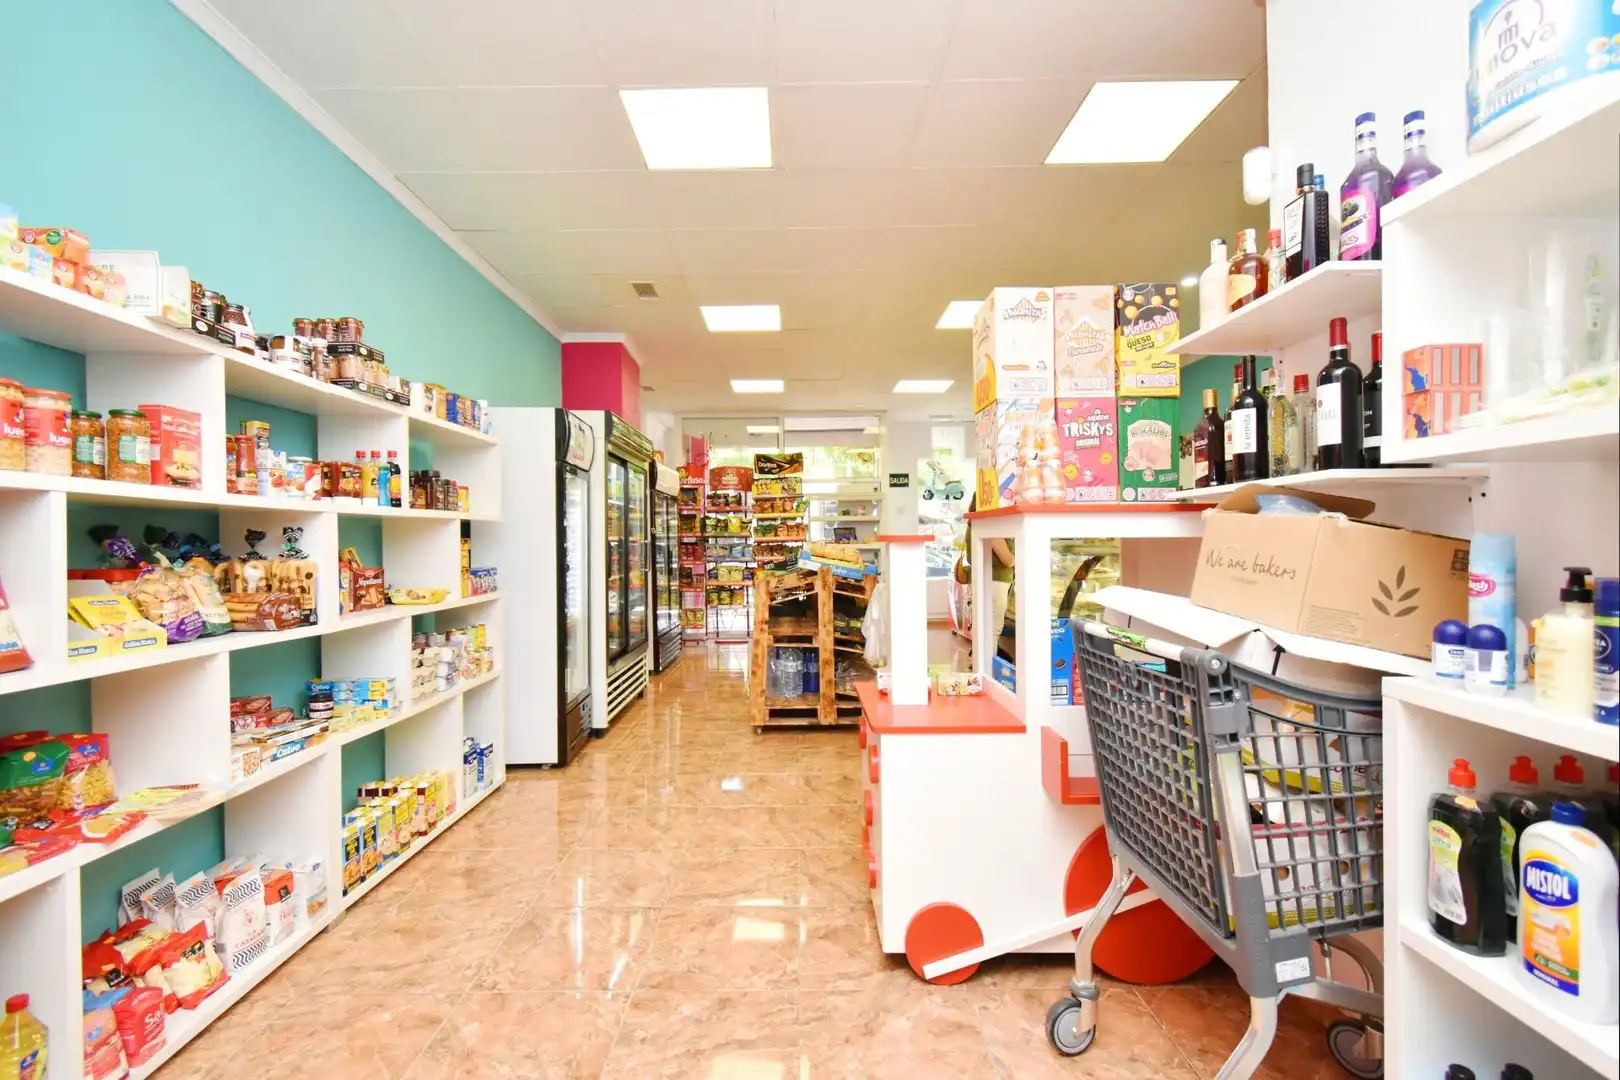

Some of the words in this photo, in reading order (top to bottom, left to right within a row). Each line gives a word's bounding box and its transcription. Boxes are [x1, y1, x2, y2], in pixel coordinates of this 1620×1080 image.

[1127, 335, 1152, 349] QUESO
[1205, 547, 1224, 568] We
[1226, 558, 1249, 571] are
[1252, 552, 1296, 580] bakers
[276, 743, 301, 758] Calvo
[1526, 865, 1572, 900] MISTOL
